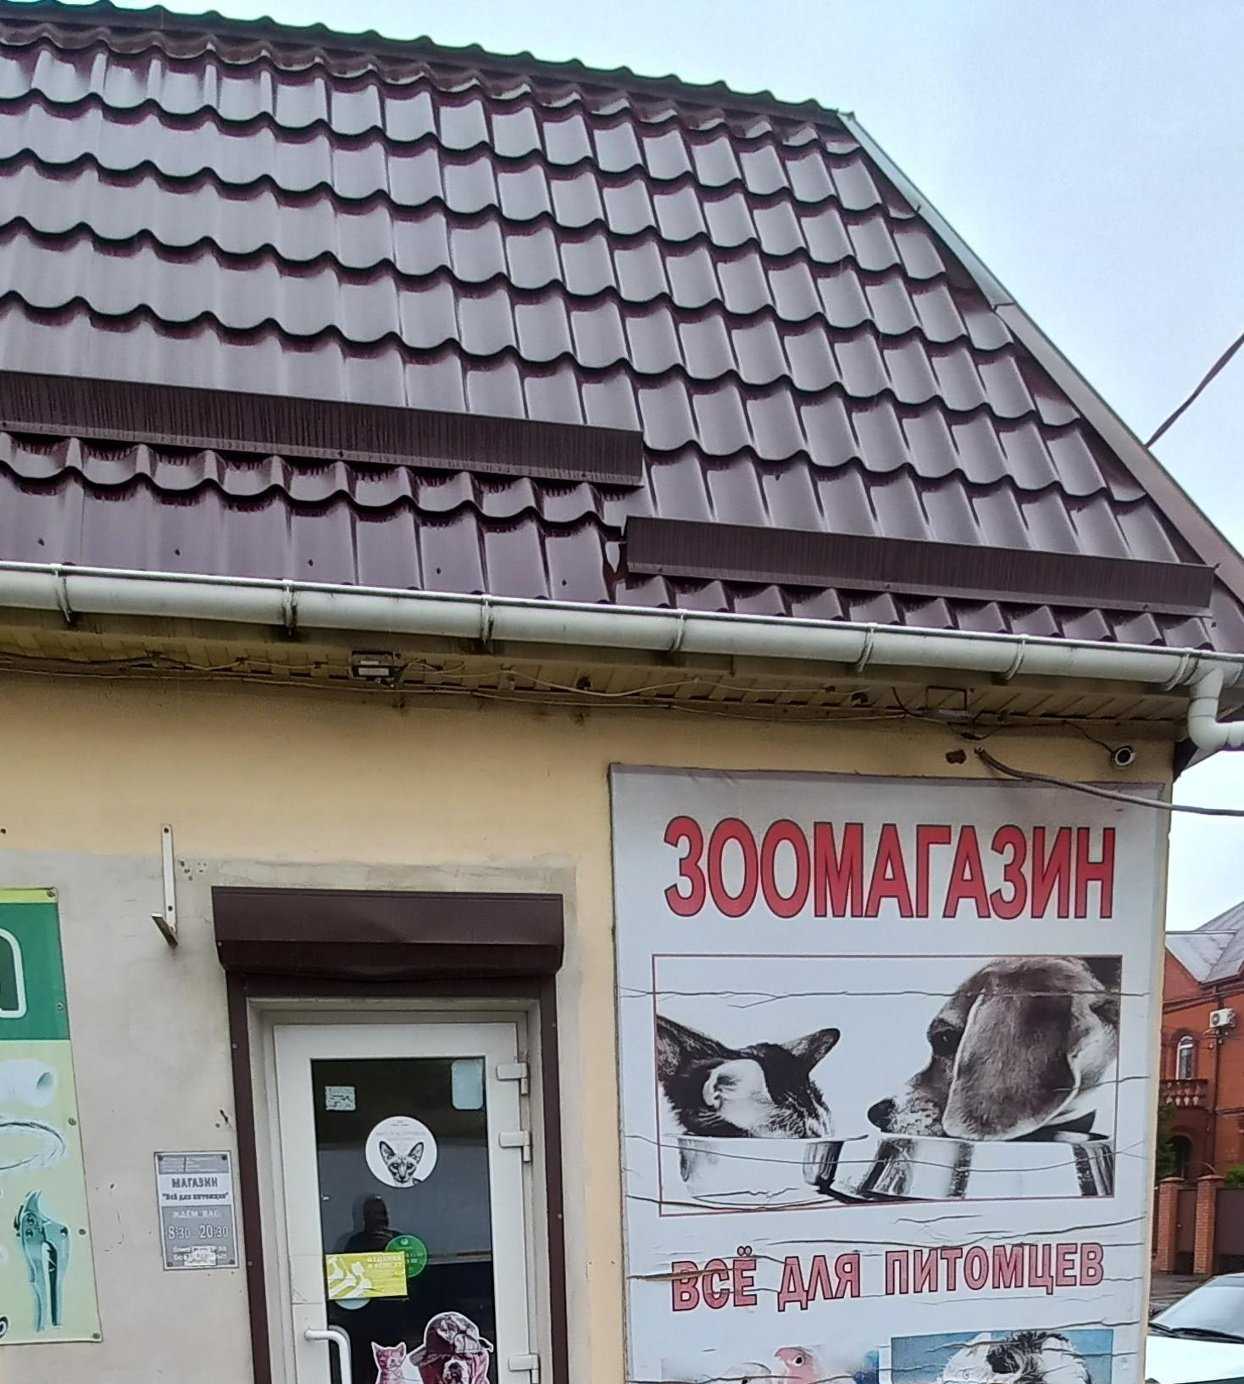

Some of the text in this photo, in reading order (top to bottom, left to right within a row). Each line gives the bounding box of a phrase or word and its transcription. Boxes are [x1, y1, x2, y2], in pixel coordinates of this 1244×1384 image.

[663, 815, 1116, 920] ЗООМАГАЗИН
[171, 1177, 218, 1188] МАГАЗИН
[672, 1242, 1104, 1312] ВСЁ ДЛЯ ПИТОМЦЕВ
